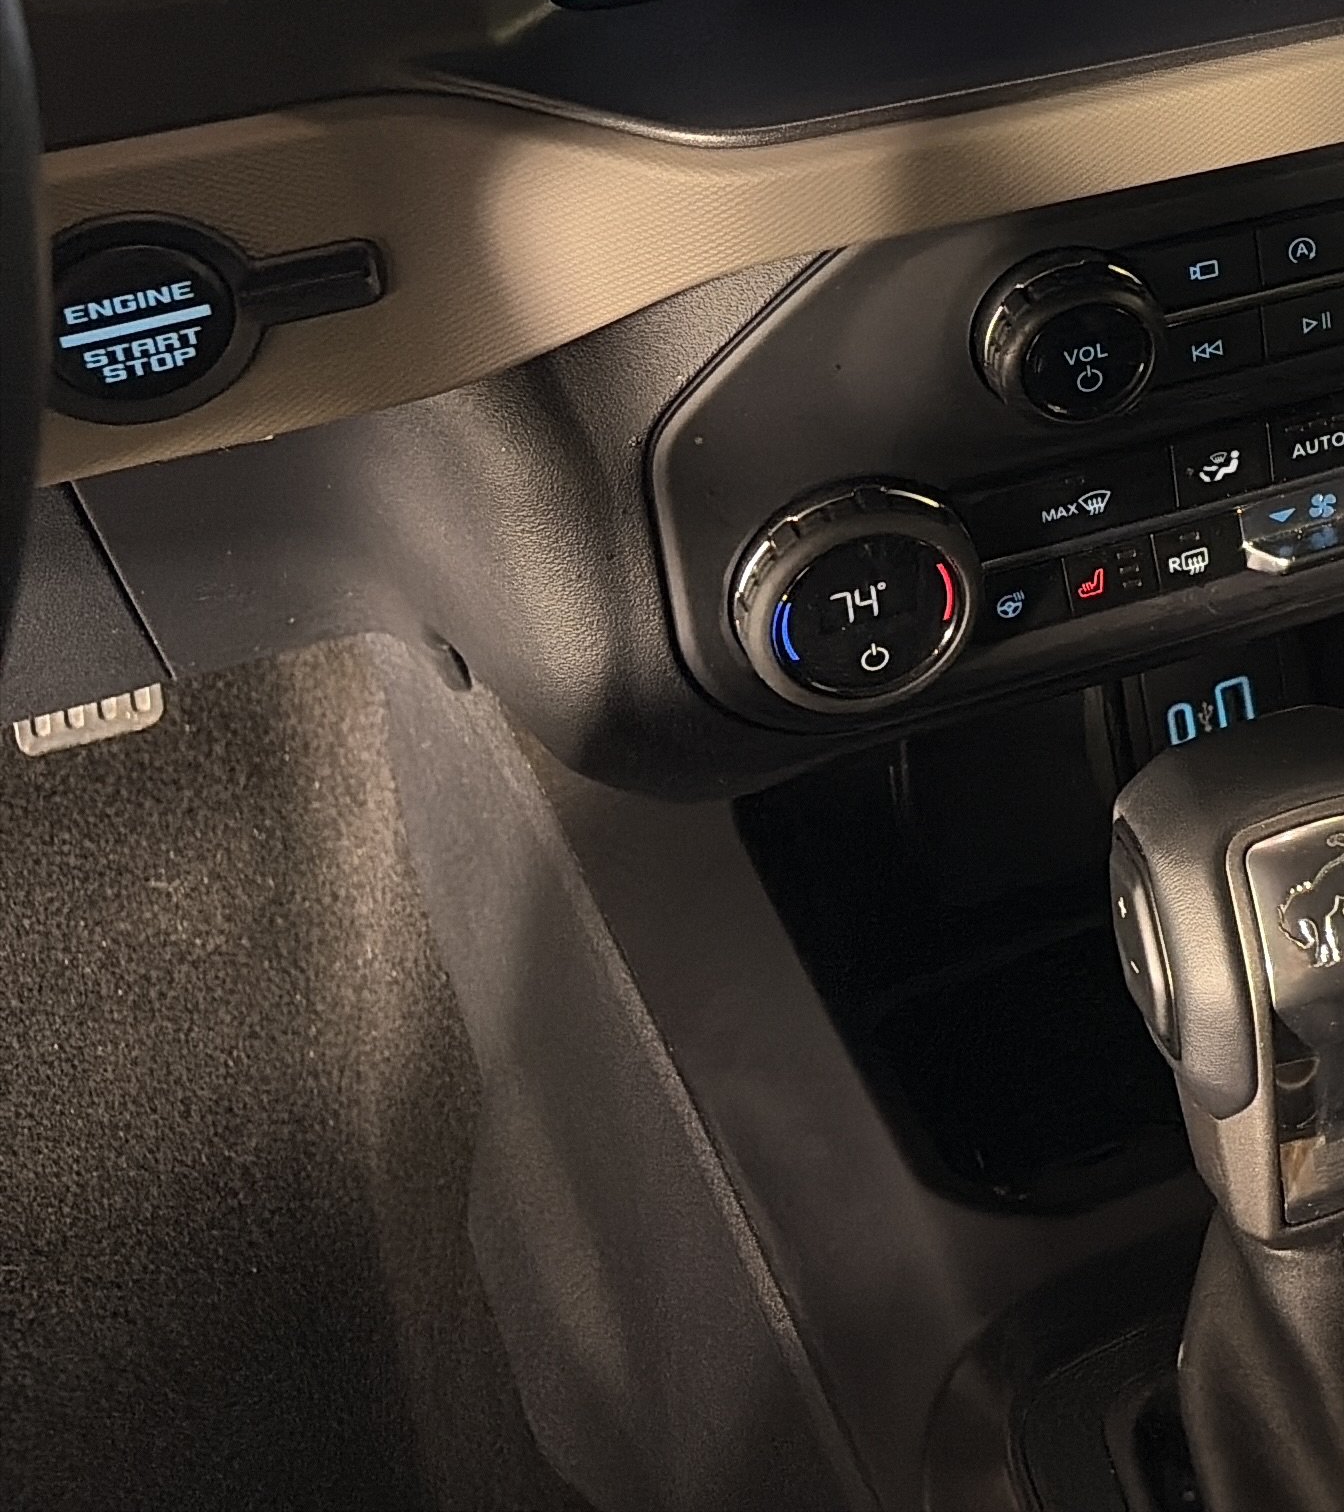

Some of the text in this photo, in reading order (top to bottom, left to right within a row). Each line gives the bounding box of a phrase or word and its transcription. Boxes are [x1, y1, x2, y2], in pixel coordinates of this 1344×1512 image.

[63, 280, 195, 325] ENGINE
[83, 326, 203, 369] START
[1064, 345, 1109, 368] VOL
[102, 348, 197, 384] STOP
[1041, 502, 1080, 524] MAX
